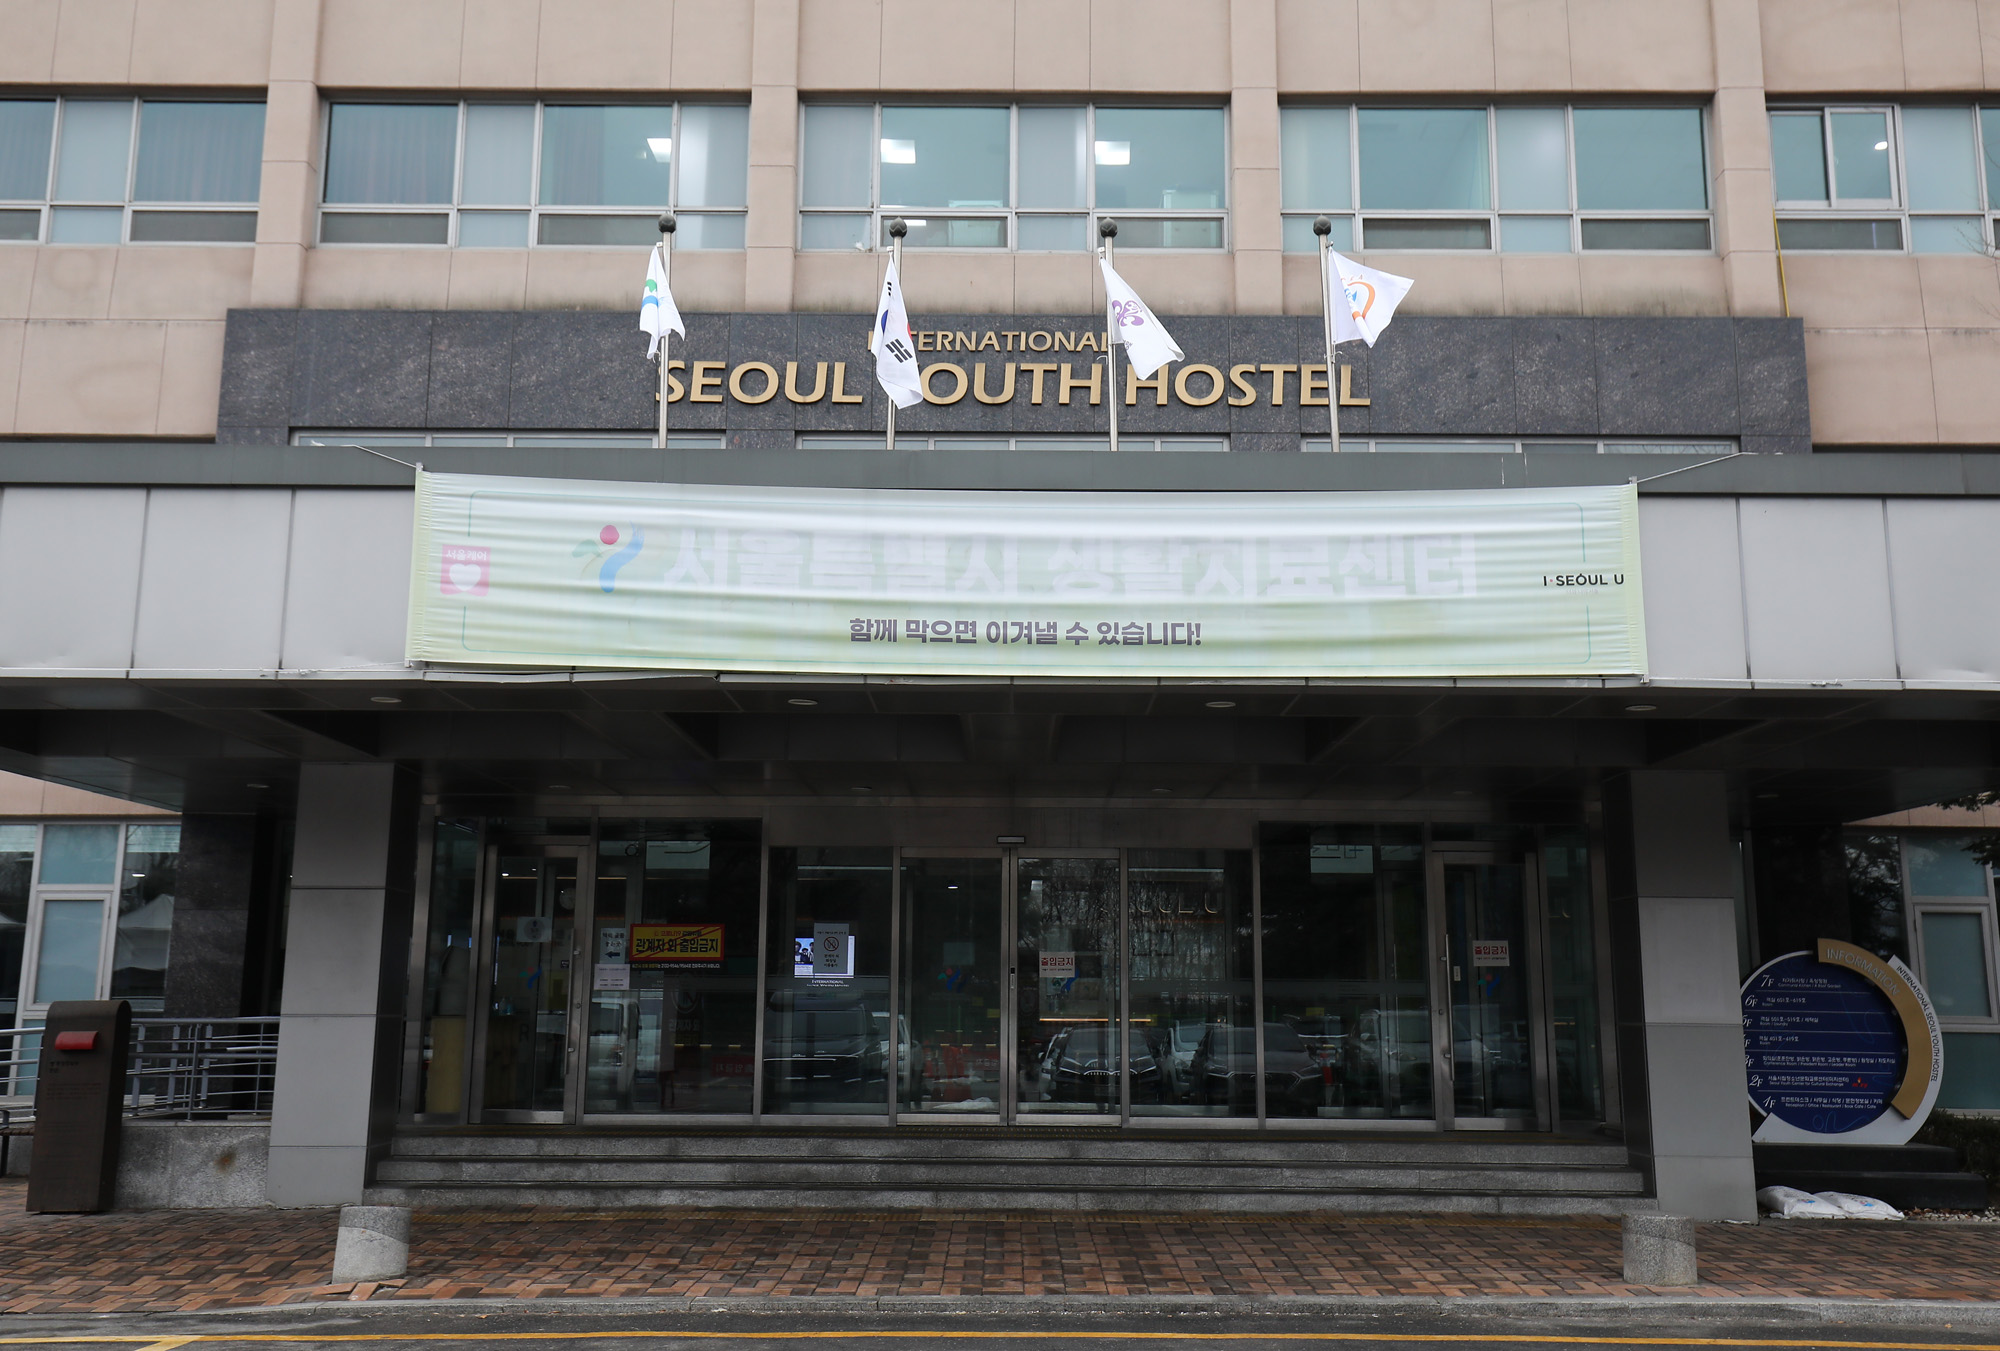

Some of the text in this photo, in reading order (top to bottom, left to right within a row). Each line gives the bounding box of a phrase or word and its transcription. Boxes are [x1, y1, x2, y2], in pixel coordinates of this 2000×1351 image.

[868, 331, 1107, 352] IERNATIONAL
[655, 360, 1371, 406] SEOUL OUTH HOSTEL
[1555, 573, 1609, 586] SEOUL
[849, 618, 1202, 646] 함께 막으면 이겨낼 수 있습니다!
[635, 938, 719, 953] 관계자 외 출입금지
[1474, 945, 1508, 955] 출입금지
[1041, 957, 1074, 966] 출입금지
[1826, 947, 1901, 997] INFORMATION
[1760, 974, 1775, 988] 7F
[1744, 994, 1759, 1008] 6F
[1896, 965, 1941, 1083] INTERNATIONAL SEOUL YOUTH HOSTEL
[1749, 1074, 1763, 1087] 2F
[1763, 1096, 1776, 1109] 1F
